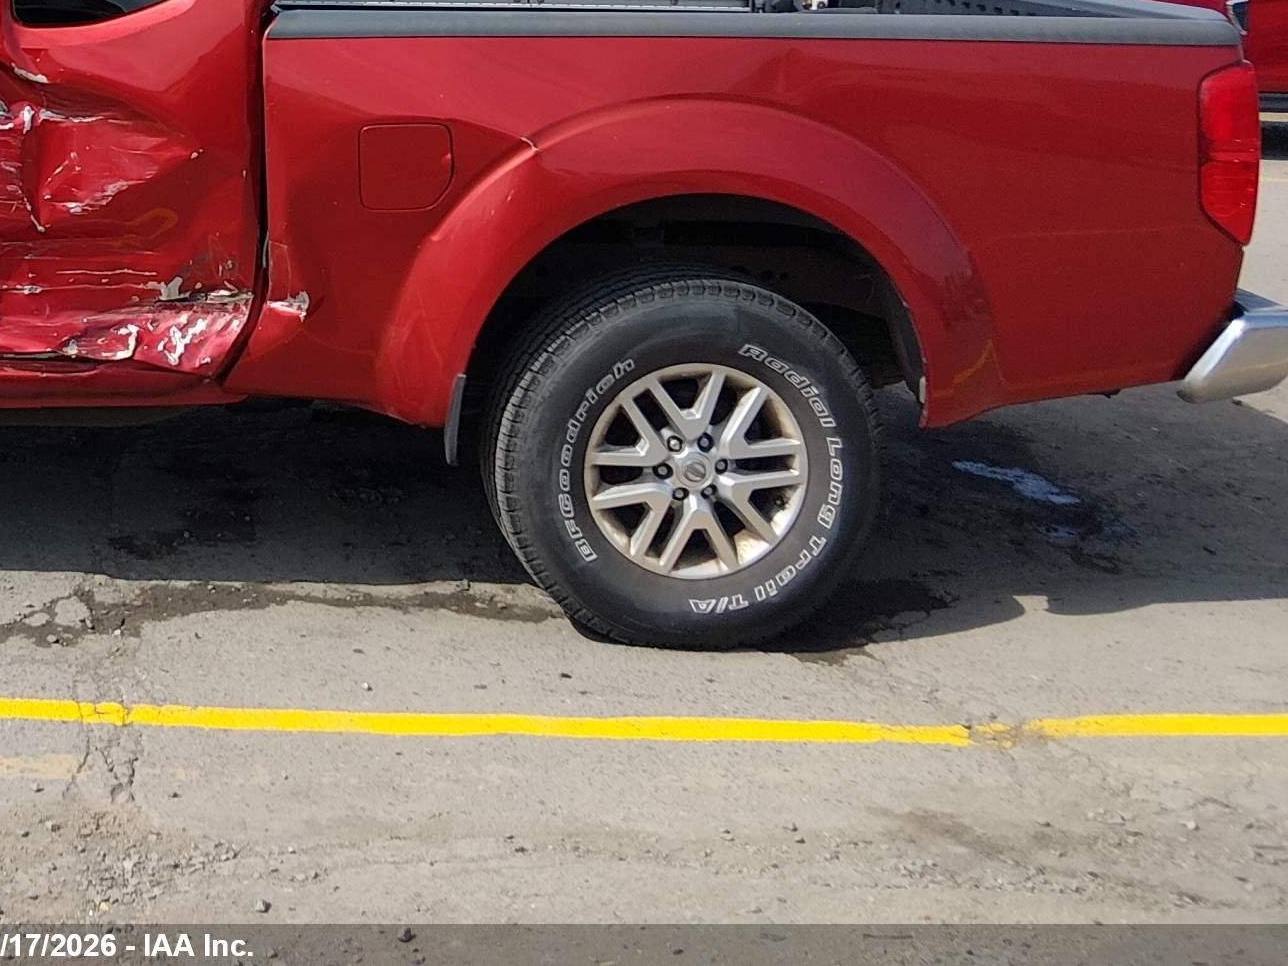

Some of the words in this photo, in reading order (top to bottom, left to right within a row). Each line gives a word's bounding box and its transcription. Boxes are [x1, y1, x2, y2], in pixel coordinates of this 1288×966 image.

[738, 344, 836, 428] Radial
[558, 358, 635, 562] BFGoodrich
[819, 437, 844, 529] Long
[689, 594, 748, 613] T/A
[755, 534, 827, 601] Trail
